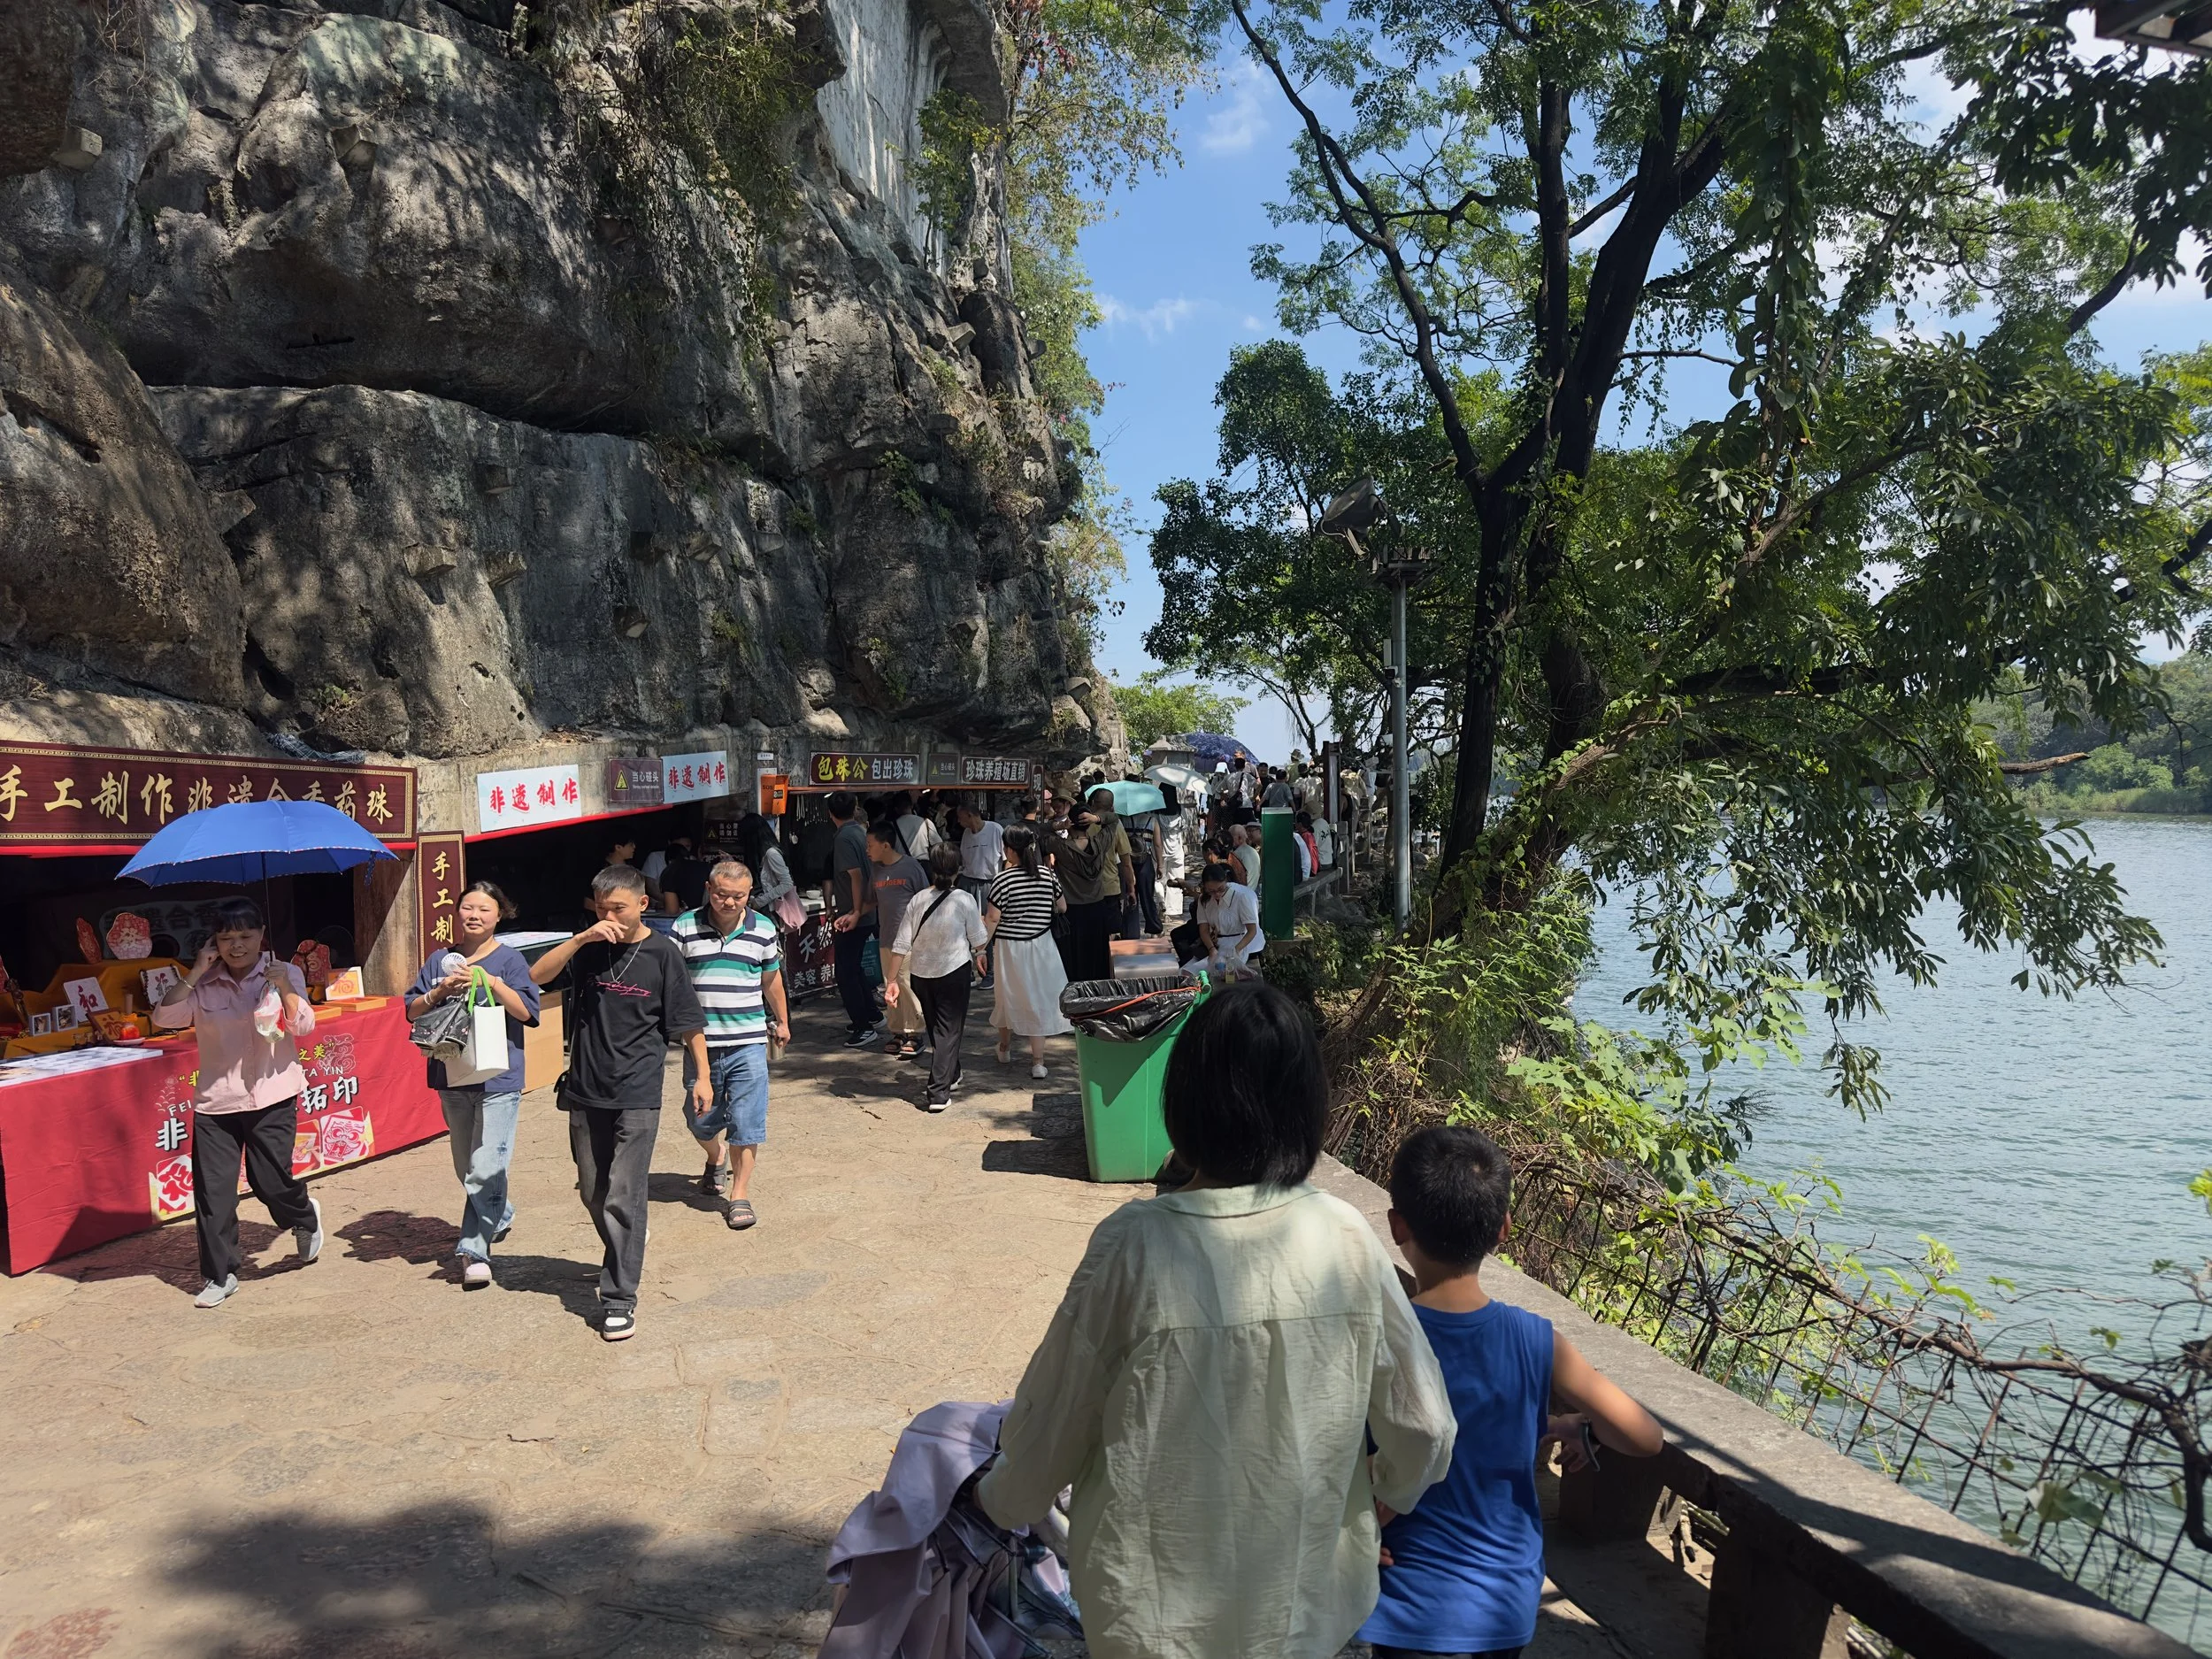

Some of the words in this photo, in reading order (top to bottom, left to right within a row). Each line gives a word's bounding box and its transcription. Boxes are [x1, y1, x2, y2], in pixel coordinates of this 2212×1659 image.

[632, 771, 659, 783] 当心碰头
[818, 755, 868, 782] 包珠公
[872, 757, 913, 780] 包出珍珠
[965, 759, 1026, 781] 珍珠养殖场直销
[794, 968, 817, 989] 美容
[820, 964, 835, 983] 养
[168, 1100, 192, 1117] FEI
[323, 1066, 343, 1076] YIN
[155, 1118, 188, 1151] 非
[300, 1076, 358, 1115] 拓印
